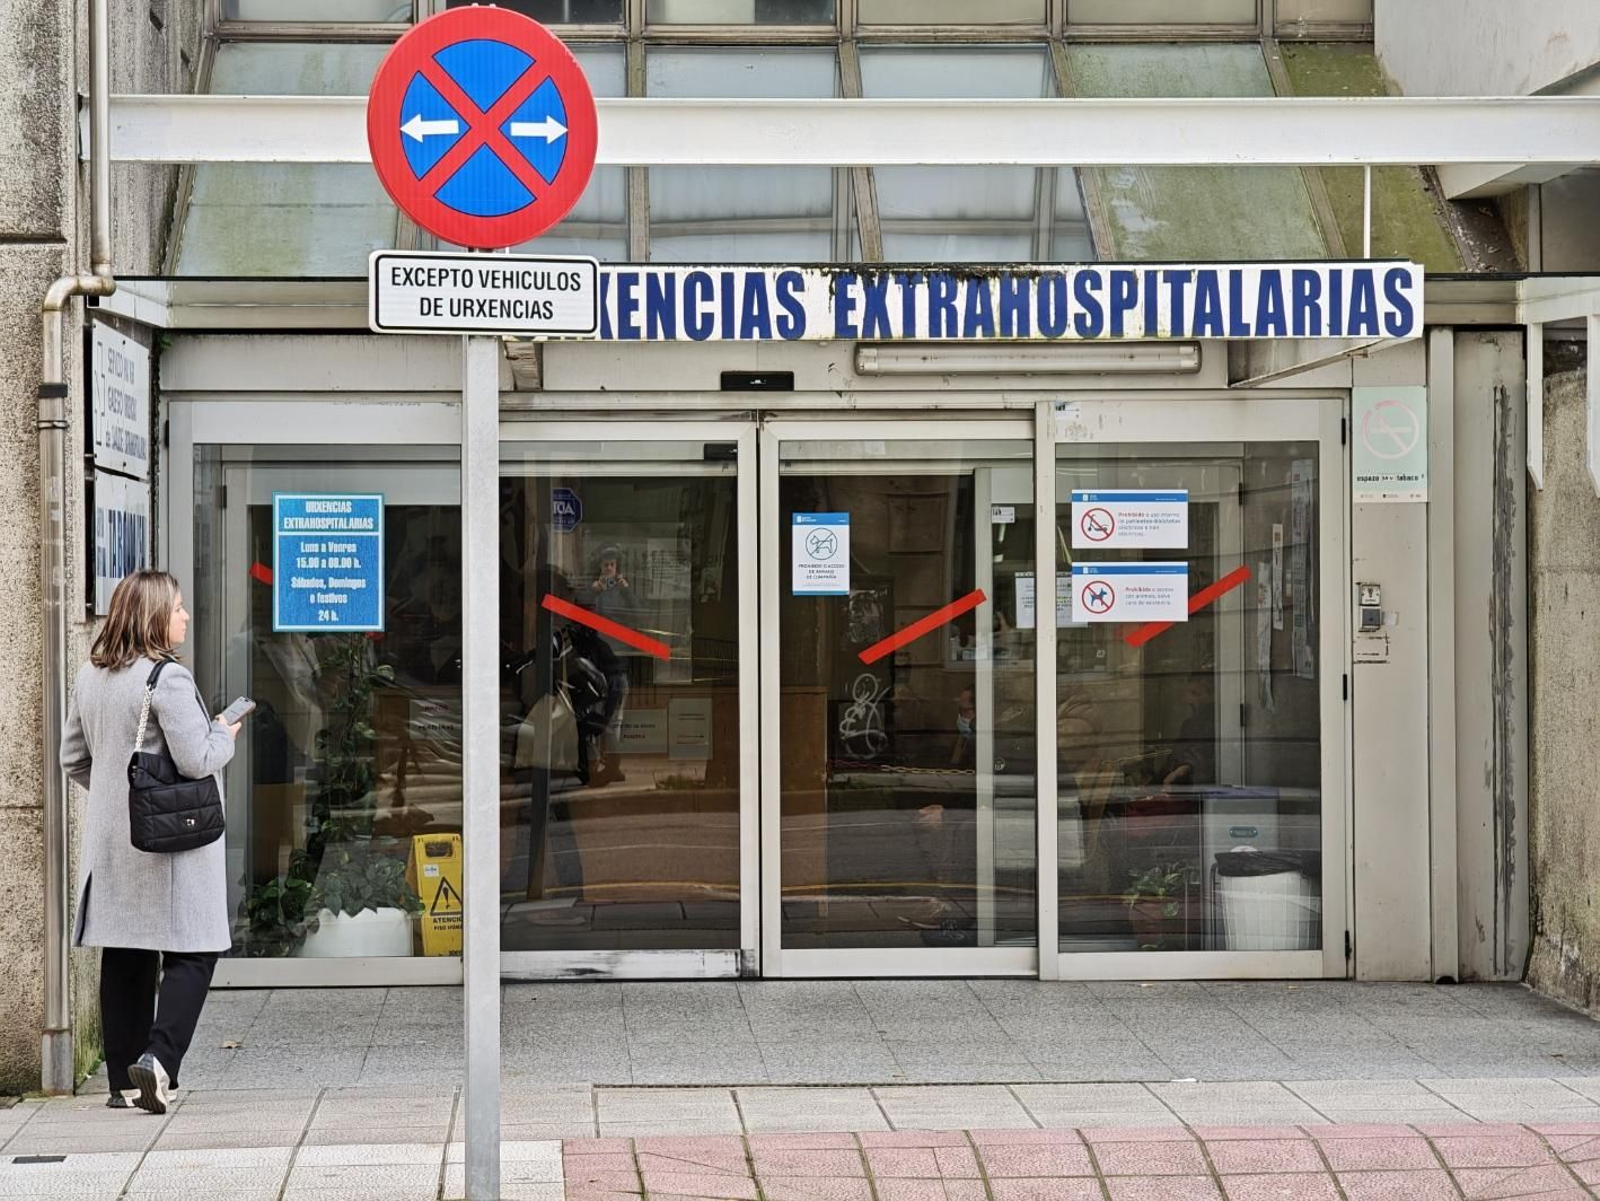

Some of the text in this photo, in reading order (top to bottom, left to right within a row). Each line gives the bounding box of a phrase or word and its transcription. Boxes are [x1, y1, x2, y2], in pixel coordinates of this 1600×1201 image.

[391, 267, 581, 291] EXCEPTO VEHICULOS
[420, 297, 554, 320] DE URXENCIAS
[834, 267, 1413, 340] EXTRAHOSPITALARIAS
[305, 501, 352, 513] URXENCIAS
[283, 517, 374, 529] EXTRAHOSPITALARIAS
[296, 557, 319, 569] 15.00
[318, 610, 330, 621] 24
